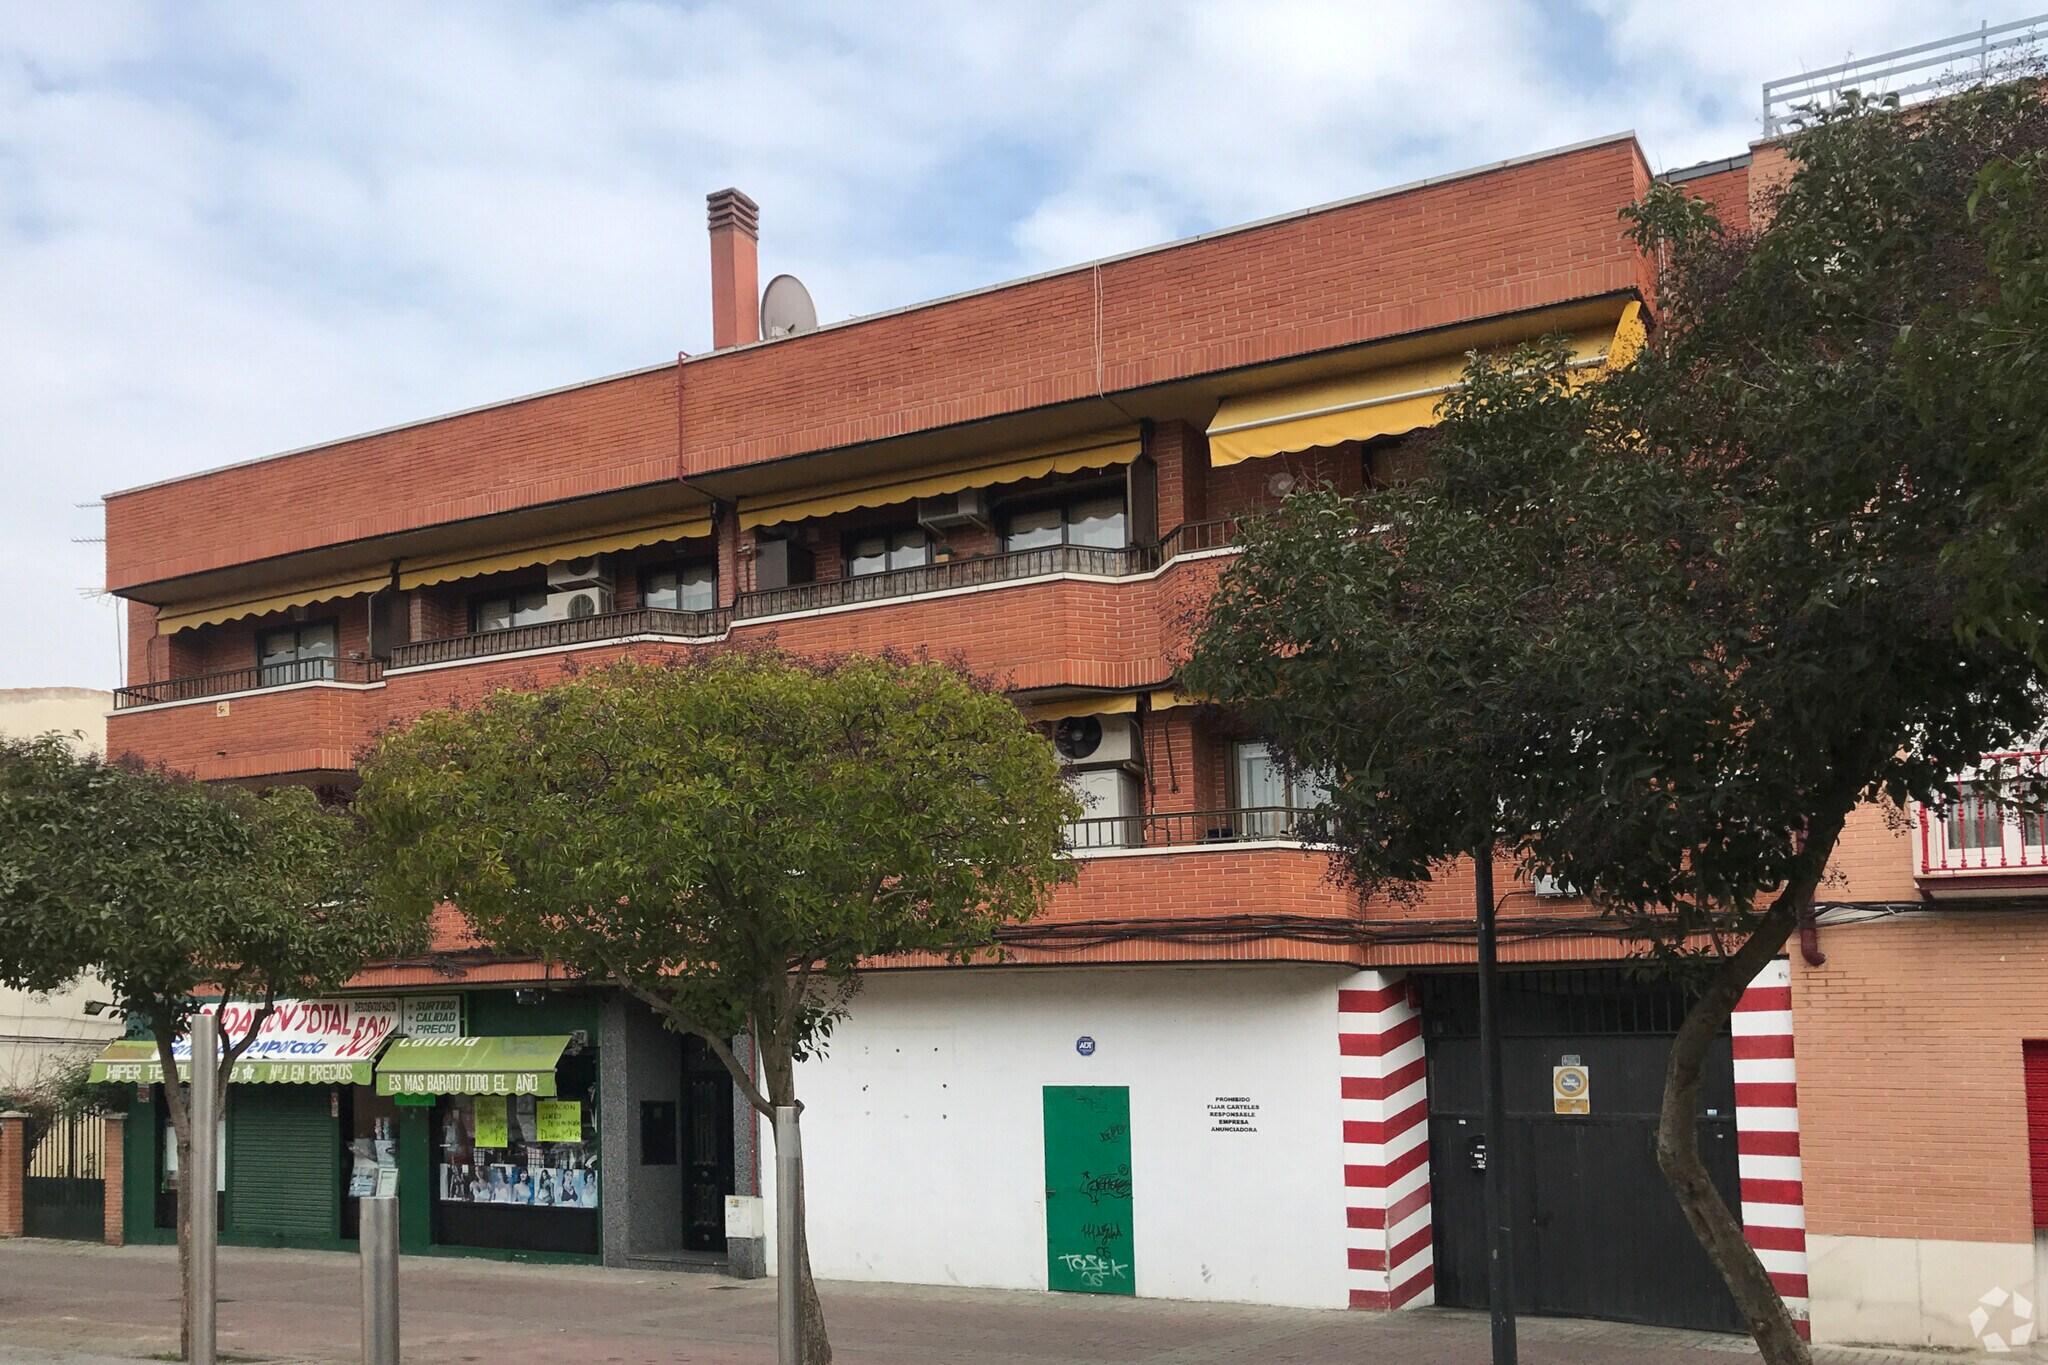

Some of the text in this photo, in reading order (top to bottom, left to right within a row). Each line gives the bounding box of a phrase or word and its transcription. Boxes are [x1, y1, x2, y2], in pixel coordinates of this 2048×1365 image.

[354, 1001, 397, 1013] DESCUENTOS HASTA
[415, 1001, 457, 1011] SURTIDO
[294, 1003, 351, 1036] TOTAL
[415, 1012, 457, 1022] CALIDAD
[336, 1015, 391, 1056] 50%
[415, 1024, 457, 1034] PRECIO
[1079, 1041, 1093, 1049] ADT
[105, 1064, 191, 1080] HIPER TEIL
[290, 1063, 305, 1080] EN
[309, 1063, 353, 1080] PRECIOS
[388, 1073, 538, 1092] ES MAS BARATO TODO EL AÑO
